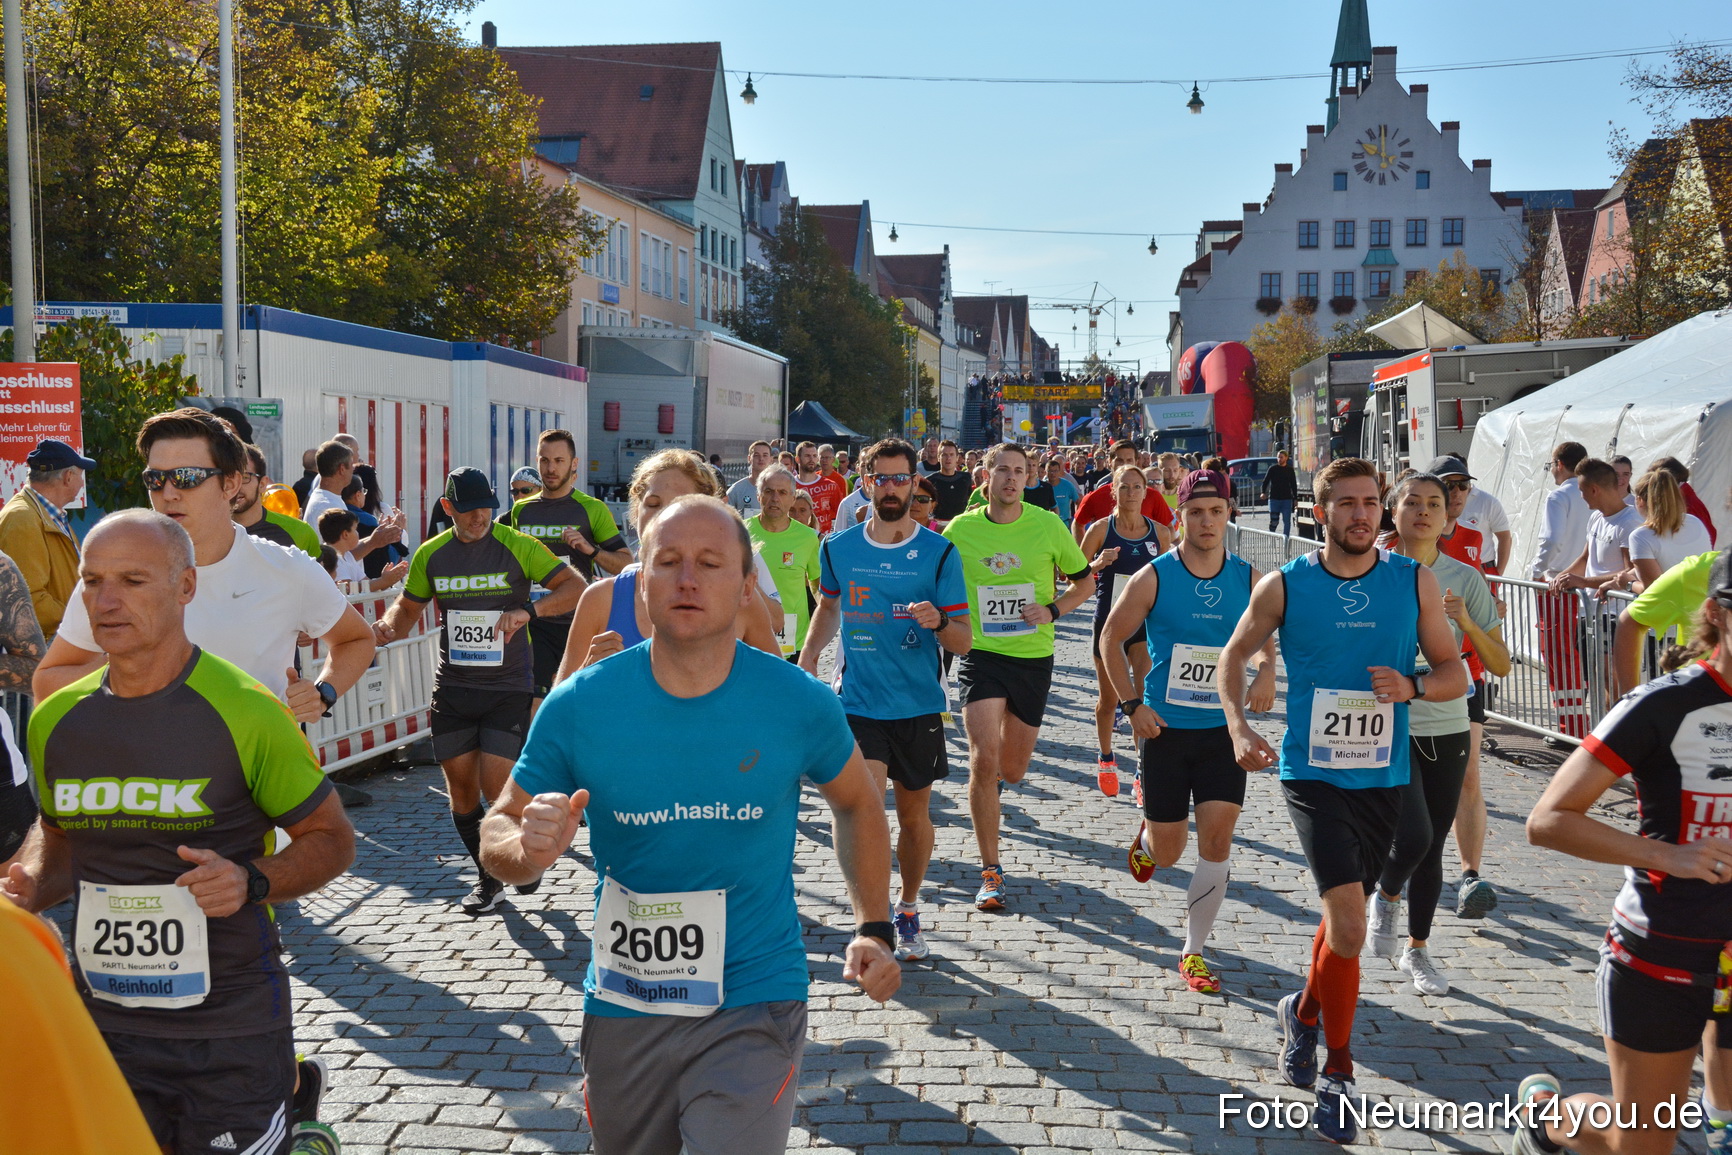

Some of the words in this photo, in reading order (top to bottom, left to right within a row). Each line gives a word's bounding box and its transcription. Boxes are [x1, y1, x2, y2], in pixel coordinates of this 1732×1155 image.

[1034, 387, 1069, 397] START
[27, 423, 57, 432] Lehrer
[59, 422, 71, 431] für
[520, 526, 577, 537] BOC
[434, 573, 510, 592] BOCK
[485, 589, 513, 598] concepts
[987, 598, 1027, 615] 2175
[454, 626, 494, 643] 2634
[461, 652, 486, 660] Markus
[1192, 651, 1220, 659] BOCK
[1190, 693, 1211, 702] Josef
[1338, 698, 1376, 707] BOCK
[1324, 712, 1384, 736] 2110
[1335, 751, 1370, 759] Michael
[55, 780, 206, 815] BOCK
[613, 802, 763, 825] www.hasit.de
[92, 818, 108, 830] by
[111, 818, 148, 829] smart
[151, 818, 215, 831] concepts
[109, 896, 164, 909] BOCK
[628, 900, 683, 917] BOCK
[93, 918, 184, 957] 2530
[610, 920, 704, 963] 2609
[102, 961, 126, 970] PARTL
[128, 962, 166, 970] Neumarkt
[618, 961, 642, 975] PARTL
[644, 967, 684, 976] Neumarkt
[109, 977, 173, 994] Reinhold
[625, 979, 688, 1002] Stephan
[210, 1138, 237, 1150] adidas
